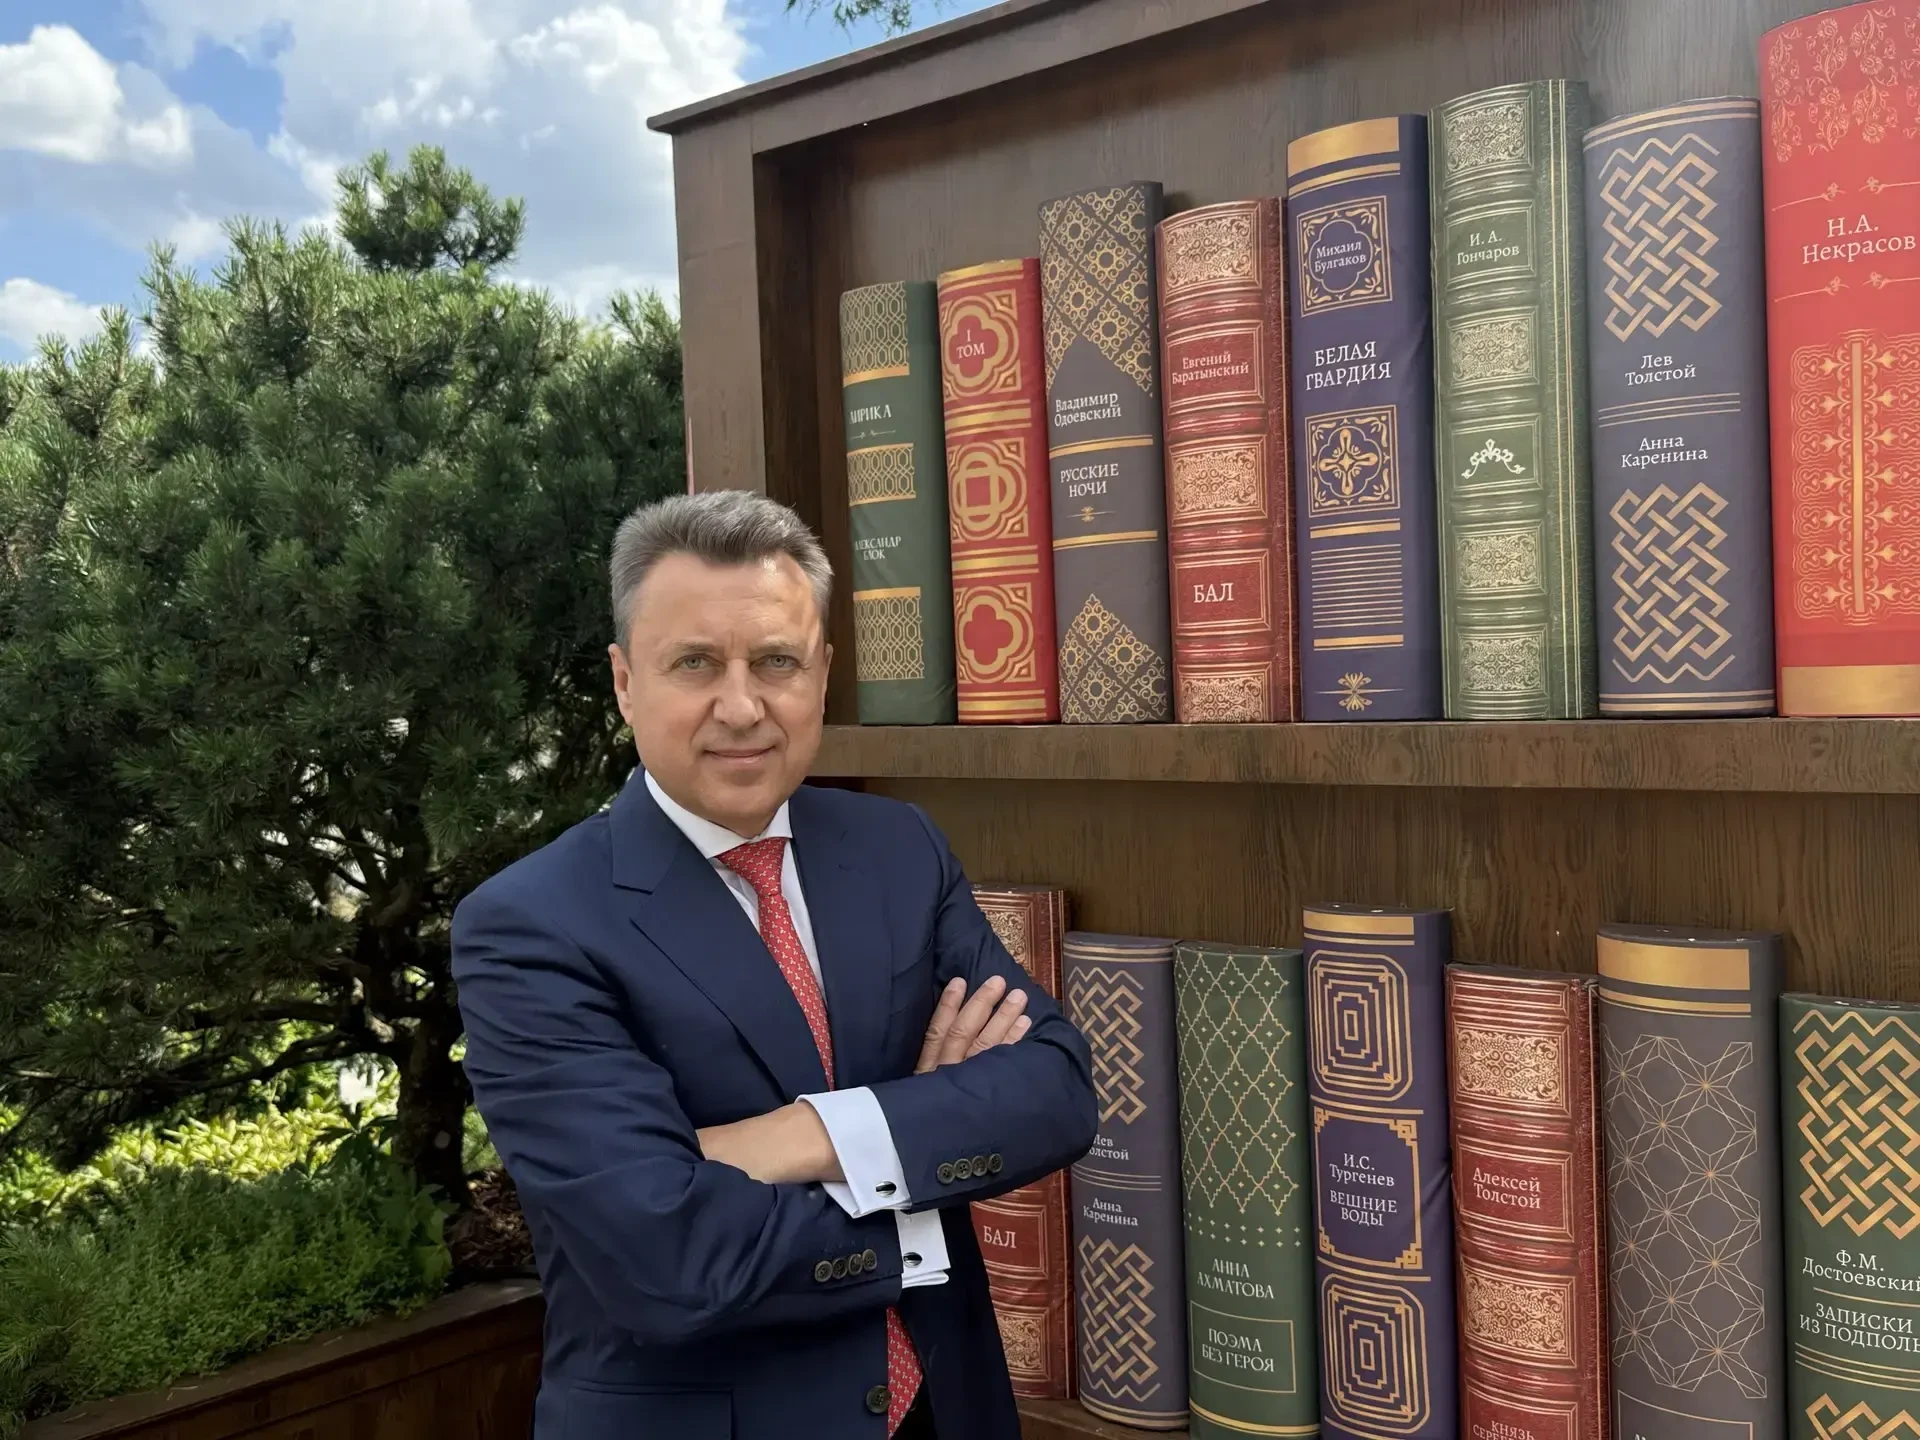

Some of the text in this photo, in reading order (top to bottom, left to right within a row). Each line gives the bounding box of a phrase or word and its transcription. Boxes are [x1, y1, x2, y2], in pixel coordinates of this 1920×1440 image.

[1826, 213, 1879, 238] Н.А.
[1469, 230, 1502, 247] И. А.
[1316, 241, 1362, 259] Михаил
[1457, 245, 1520, 266] Гончаров
[1802, 235, 1917, 265] Некрасов
[1314, 254, 1367, 274] Булгаков
[956, 342, 985, 359] ТОМ
[1182, 350, 1232, 370] Евгений
[1315, 341, 1377, 367] БЕЛАЯ
[1640, 354, 1673, 369] Лев
[1172, 361, 1249, 386] Баратынский
[1305, 361, 1392, 390] ГВАРДИЯ
[1624, 364, 1697, 386] Толстой
[1055, 393, 1119, 413] Владимир
[1054, 405, 1122, 427] Одоевский
[1639, 436, 1685, 452] Анна
[1621, 449, 1709, 470] Каренина
[1060, 463, 1119, 483] РУССКИЕ
[1069, 480, 1107, 498] НОЧИ
[863, 549, 886, 561] БЛОК
[1193, 582, 1235, 604] БАЛ
[1089, 1146, 1130, 1161] олстой
[1343, 1152, 1376, 1171] И.С.
[1328, 1163, 1395, 1187] Тургенев
[1472, 1167, 1541, 1193] Алексей
[1092, 1197, 1123, 1213] Анна
[1329, 1189, 1398, 1213] ВЕШНИЕ
[1473, 1182, 1541, 1209] Толстой
[1083, 1206, 1139, 1227] Каренина
[1340, 1206, 1385, 1227] ВОДЫ
[983, 1225, 1017, 1249] БАЛ
[1212, 1258, 1250, 1279] АННА
[1836, 1249, 1884, 1272] Ф.М.
[1197, 1271, 1275, 1300] АХМАТОВА
[1800, 1313, 1821, 1334] ИЗ
[1815, 1302, 1914, 1334] ЗАПИСКИ
[1208, 1327, 1262, 1353] ПОЭМА
[1202, 1343, 1275, 1373] БЕЗ ГЕРОЯ
